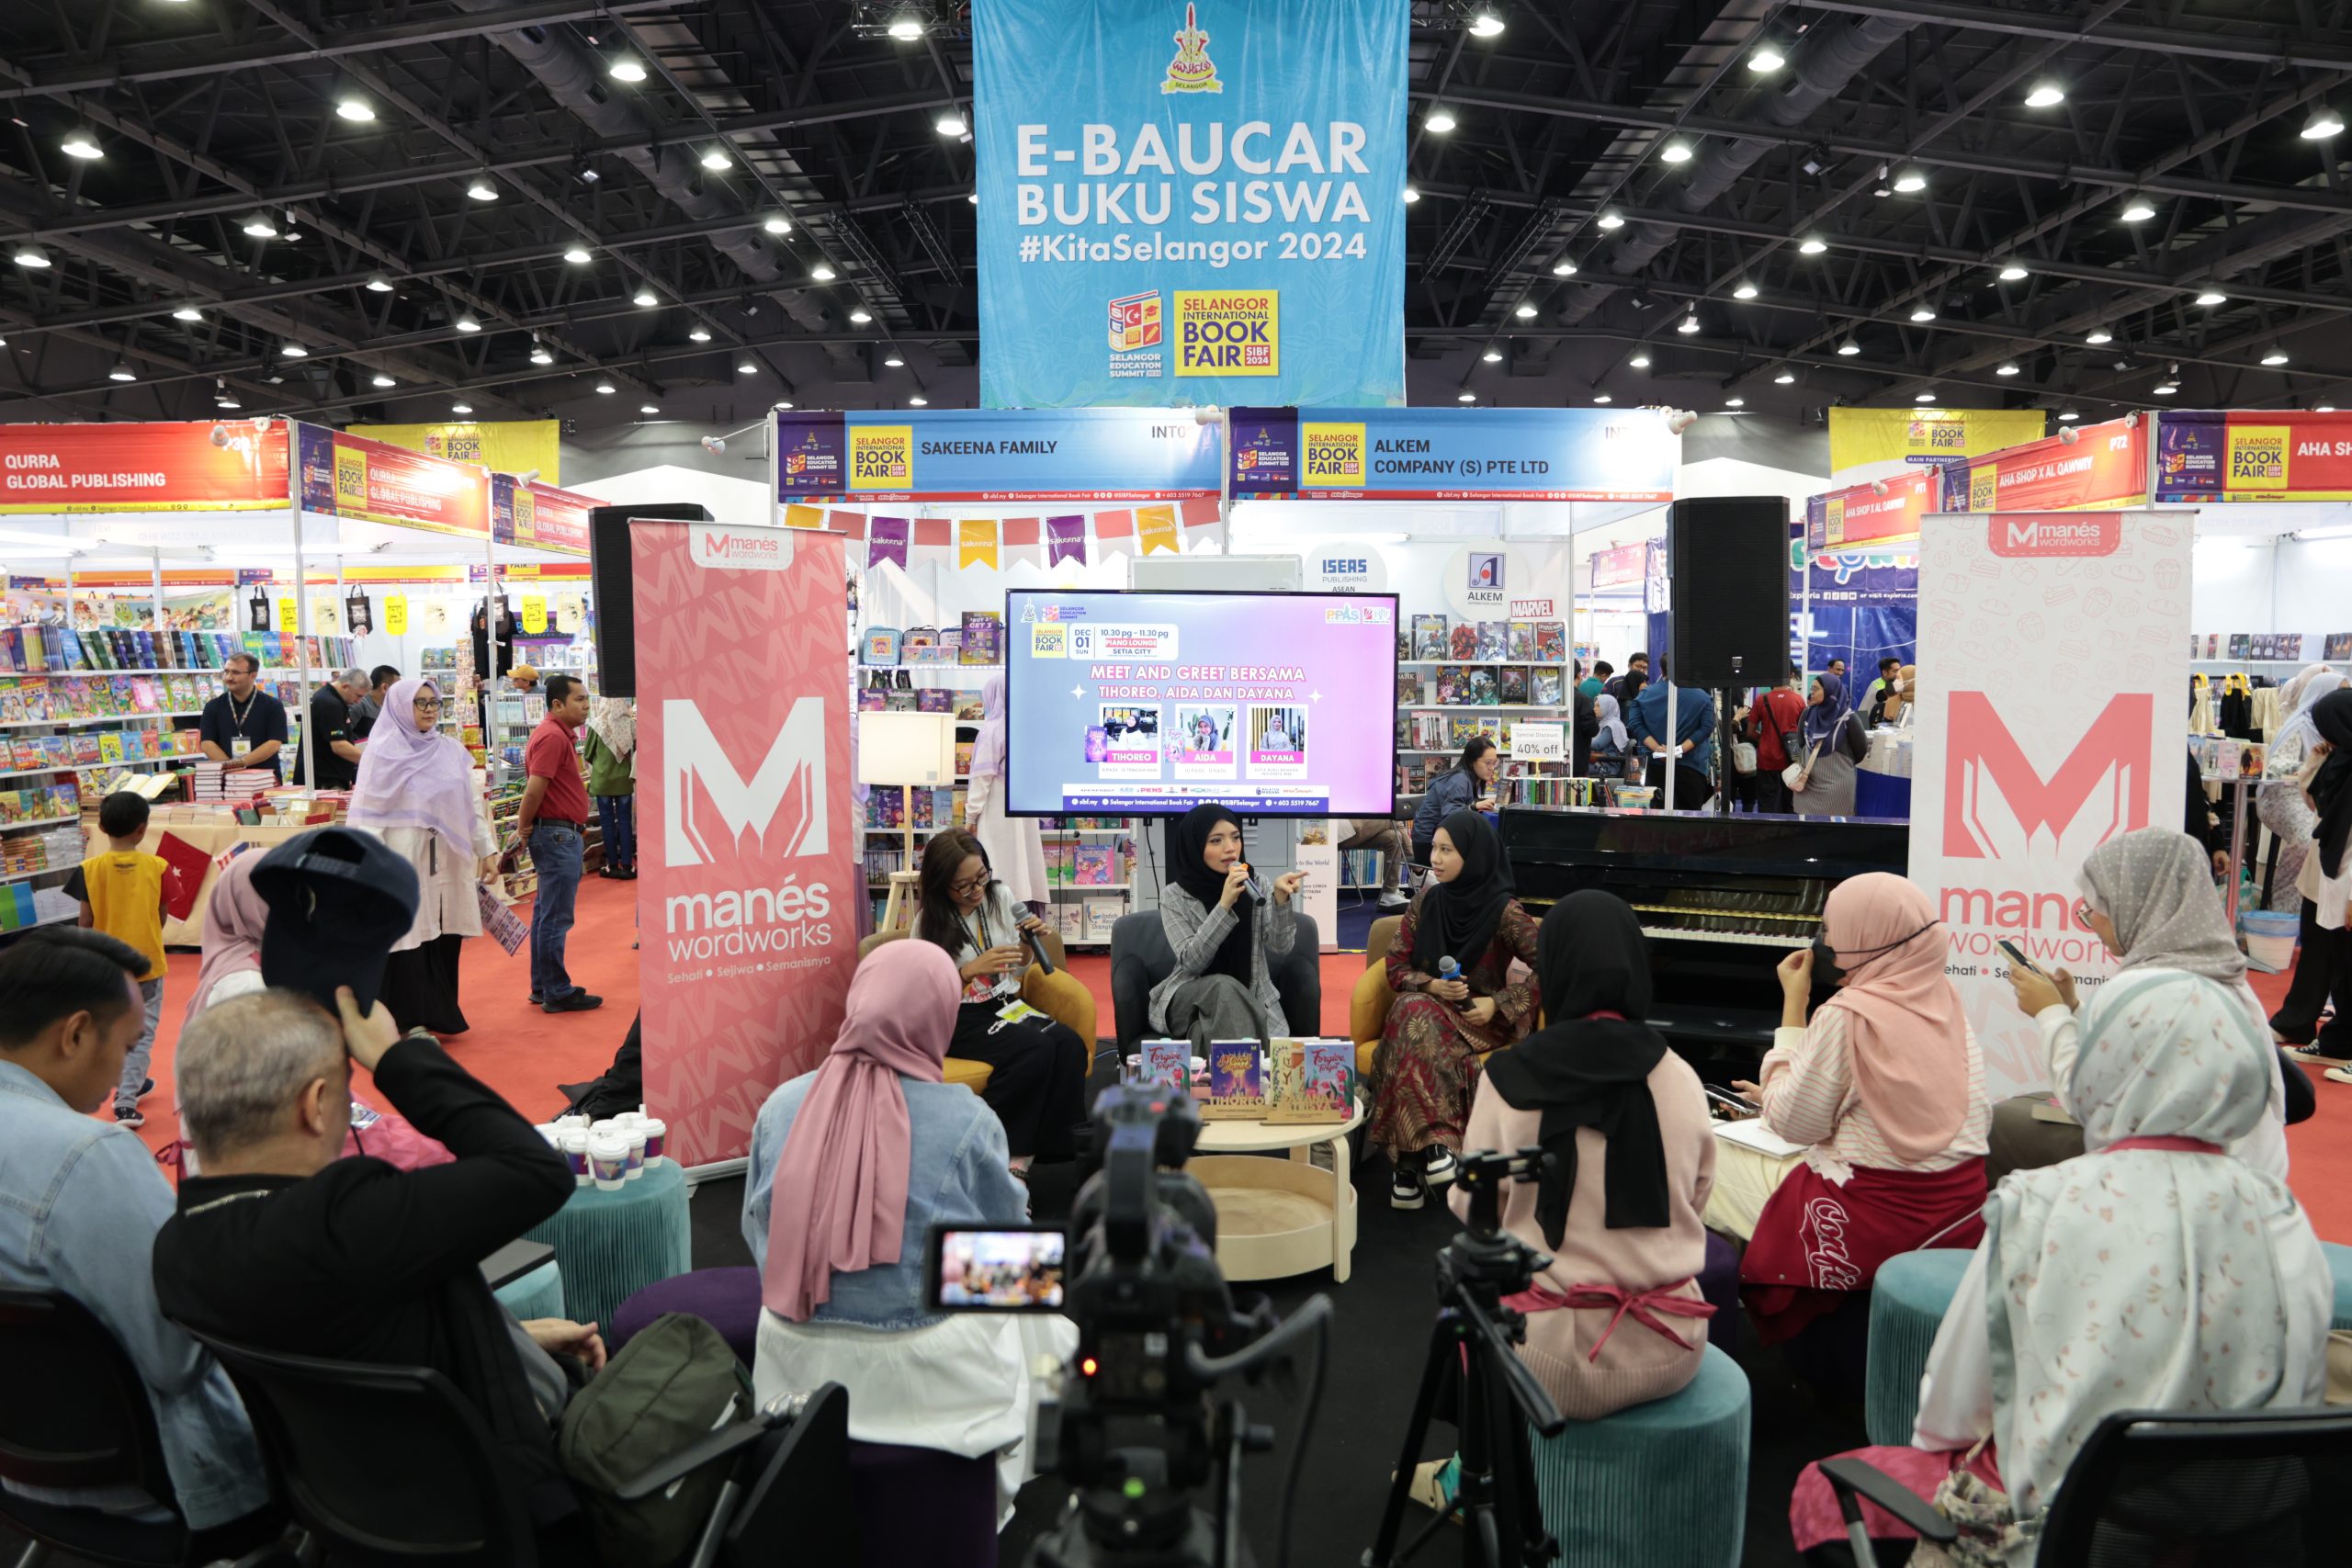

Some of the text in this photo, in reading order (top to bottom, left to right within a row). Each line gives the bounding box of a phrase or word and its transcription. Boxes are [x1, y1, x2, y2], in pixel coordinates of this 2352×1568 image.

[1017, 121, 1371, 176] E-BAUCAR
[1017, 181, 1371, 226] BUKU SISWA
[1019, 231, 1367, 269] #KitaSelangor 2024
[1184, 298, 1269, 311] SELANGOR
[1183, 311, 1270, 320] INTERNATIONAL
[1183, 321, 1270, 344] BOOK
[1183, 344, 1242, 367] FAIR
[1246, 346, 1269, 355] SIBF
[1247, 356, 1269, 365] 2024
[1931, 429, 1964, 437] BOOK
[447, 442, 480, 451] BOOK
[922, 440, 1057, 455] SAKEENA FAMILY
[1374, 440, 1430, 453] ALKEM
[1931, 439, 1953, 447] FAIR
[2109, 434, 2128, 451] P72
[447, 451, 470, 459] FAIR
[1308, 448, 1358, 460] BOOK
[2298, 443, 2331, 456] AHA
[5, 454, 60, 469] QURRA
[855, 451, 905, 464] BOOK
[2233, 451, 2281, 464] BOOK
[855, 465, 889, 478] FAIR
[1308, 462, 1342, 474] FAIR
[1374, 460, 1549, 477] COMPANY (S) PTE LTD
[1999, 456, 2093, 487] AHA SHOP X AL QAWWIY
[2233, 465, 2265, 478] FAIR
[7, 472, 165, 489] GLOBAL PUBLISHING
[338, 469, 363, 484] BOOK
[339, 483, 356, 496] FAIR
[1973, 485, 1993, 499] BOOK
[369, 487, 441, 511] GLOBAL PUBLISHING
[1973, 500, 1985, 510] FAIR
[1845, 508, 1856, 517] AHA
[1856, 505, 1870, 516] SHOP
[1871, 503, 1875, 513] X
[1875, 502, 1882, 512] AL
[536, 521, 555, 533] GLOBAL
[1140, 526, 1171, 536] sakeena
[2040, 522, 2100, 537] manés
[731, 536, 778, 551] manés
[872, 537, 903, 546] sakeena
[1049, 536, 1081, 545] sakeena
[2039, 536, 2100, 547] wordworks
[731, 550, 778, 559] wordworks
[1322, 559, 1367, 573] ISEAS
[1322, 575, 1367, 583] PUBLISHING
[1467, 592, 1502, 602] ALKEM
[1511, 601, 1552, 616] MARVEL
[1122, 630, 1132, 638] pg
[1158, 630, 1169, 638] pg
[1075, 637, 1090, 649] 01
[1090, 665, 1306, 682] MEET AND GREET BERSAMA
[1098, 685, 1295, 700] TIHOREO, AIDA DAN DAYANA
[1517, 744, 1558, 753] 40% off
[1112, 753, 1151, 761] TIHOREO
[1194, 753, 1216, 761] AIDA
[666, 873, 830, 933] manés
[668, 919, 831, 963] wordworks
[668, 955, 831, 984] Sehati Sejiwa Semanisnya
[1944, 964, 1976, 976] ehati
